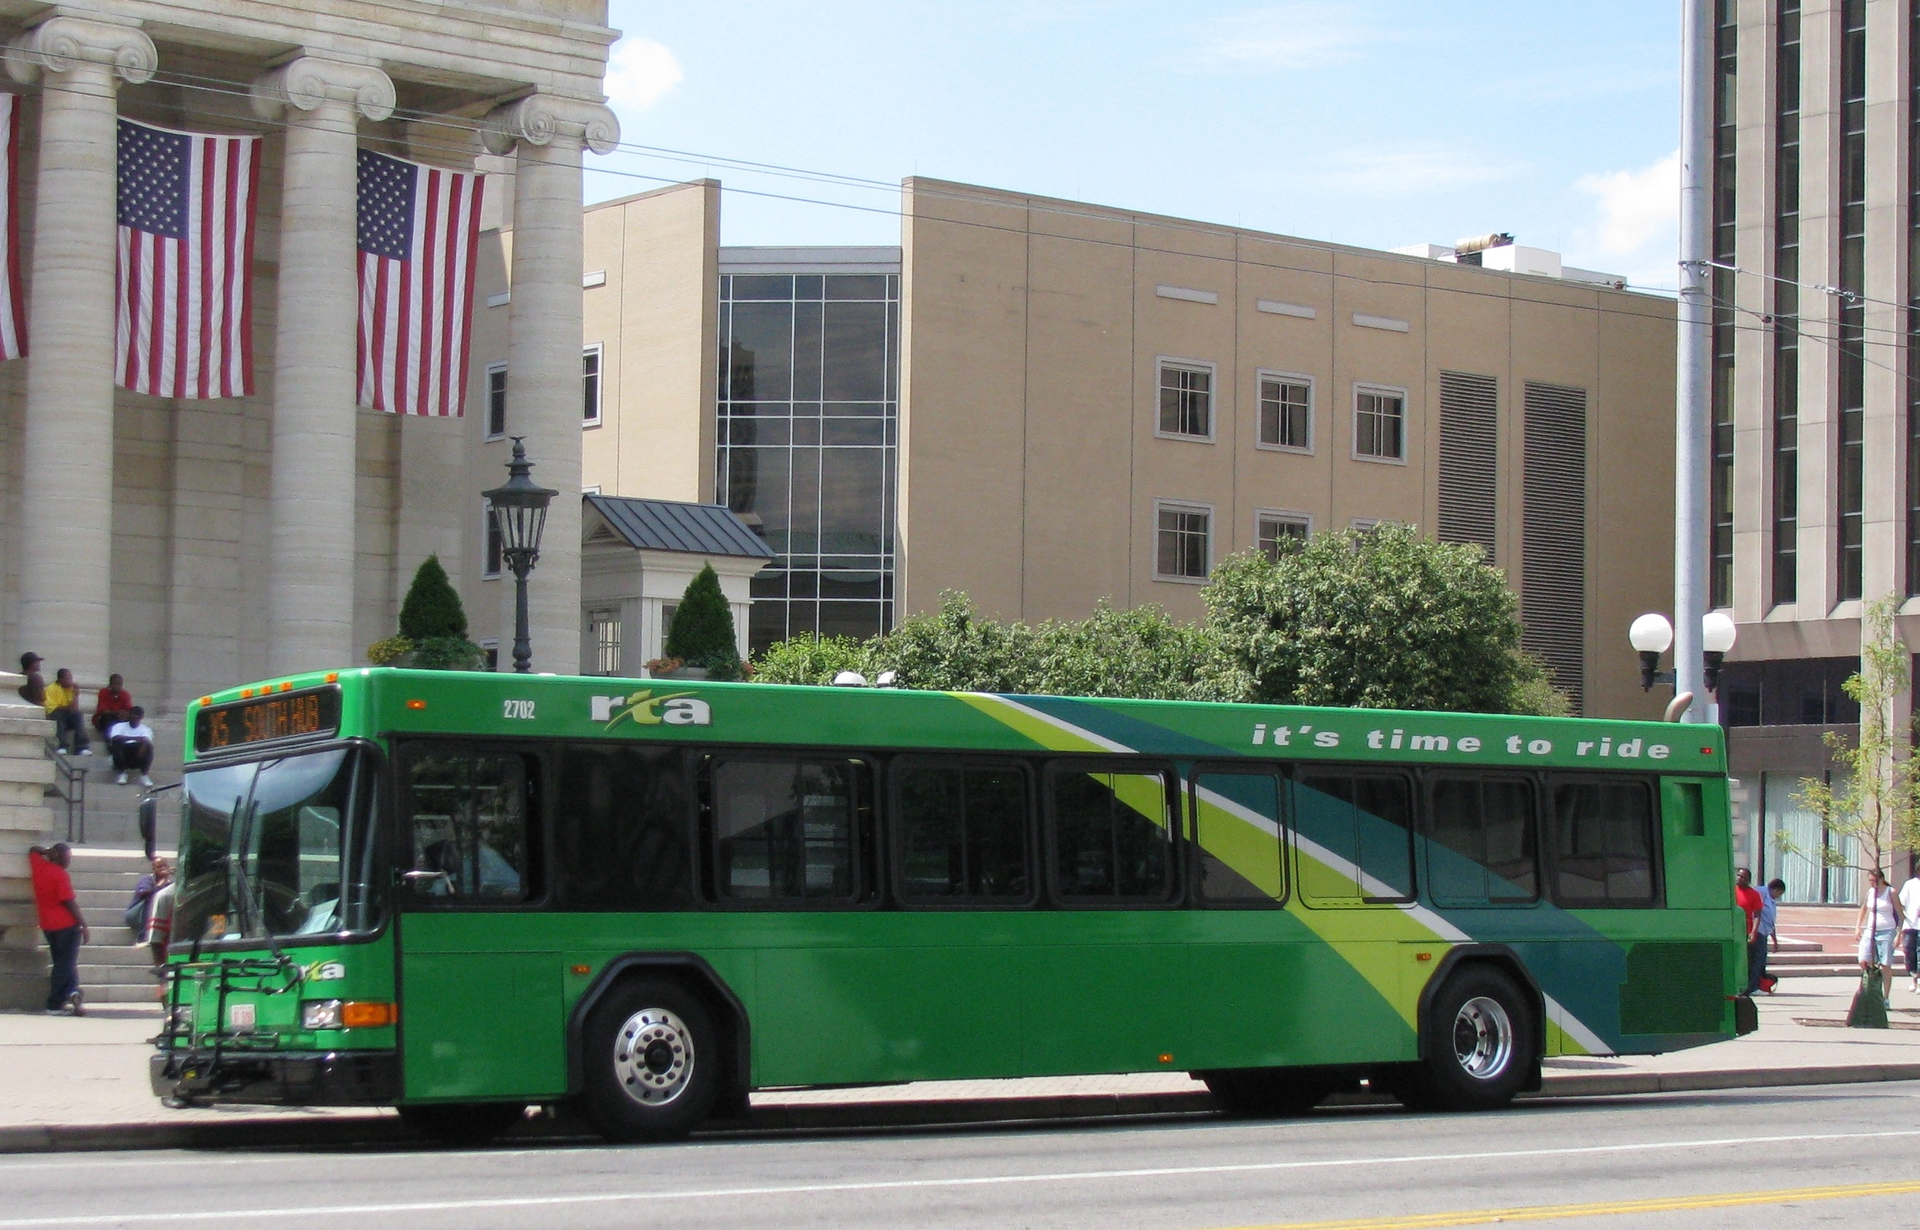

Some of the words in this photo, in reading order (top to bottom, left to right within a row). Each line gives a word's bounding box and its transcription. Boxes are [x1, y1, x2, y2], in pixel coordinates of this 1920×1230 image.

[243, 701, 288, 743] SOUTH
[290, 694, 320, 736] HUB
[504, 700, 535, 719] 2702
[591, 689, 711, 730] rta
[1252, 723, 1339, 748] it's
[1367, 729, 1480, 753] time
[1506, 734, 1552, 756] to
[1576, 737, 1671, 760] ride
